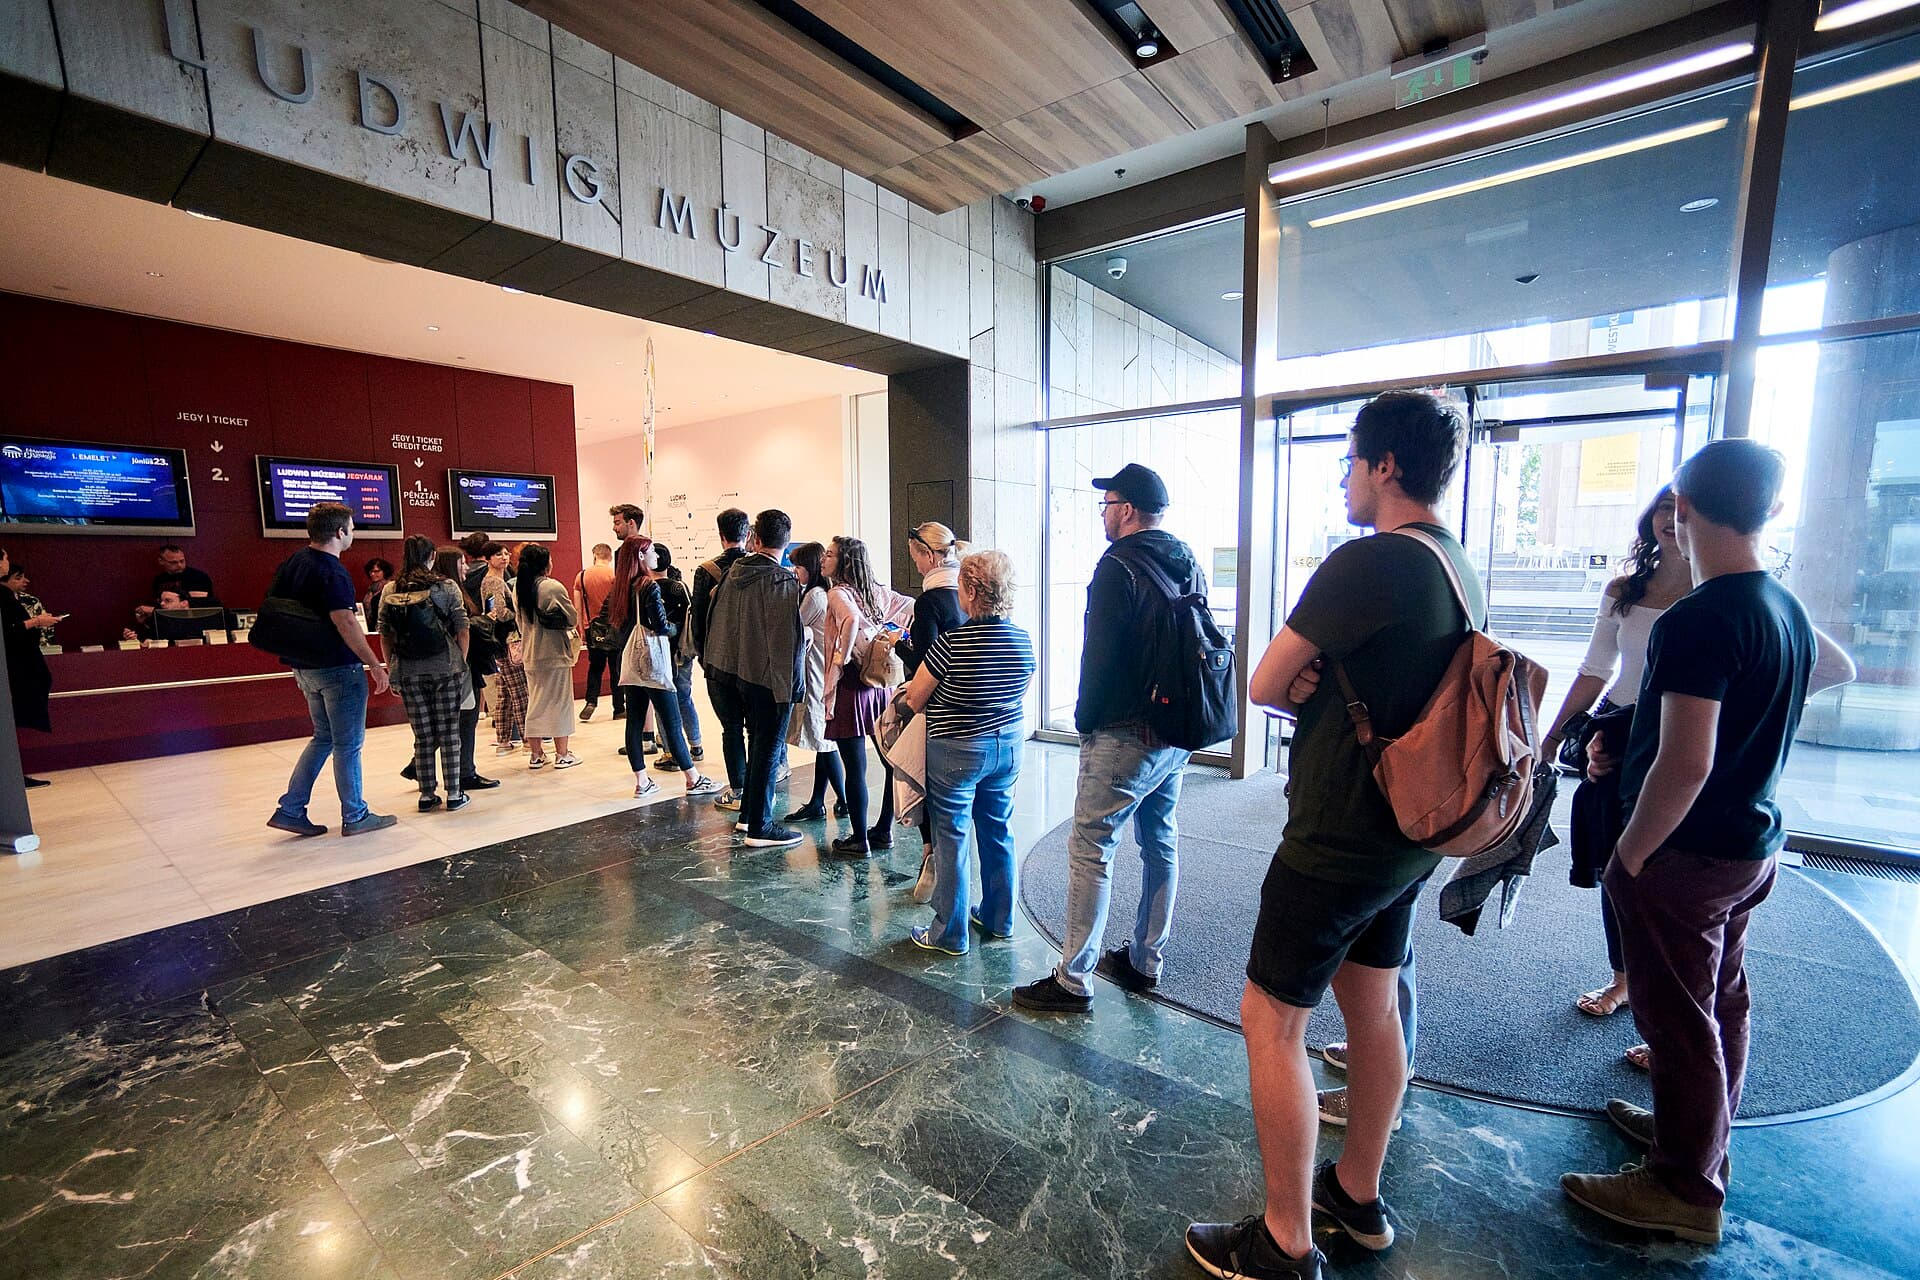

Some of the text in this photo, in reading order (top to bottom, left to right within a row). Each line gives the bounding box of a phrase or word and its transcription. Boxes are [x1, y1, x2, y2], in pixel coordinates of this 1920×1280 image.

[163, 0, 889, 304] LUDWIG MÚZEUM
[176, 411, 204, 422] JEGY
[212, 415, 249, 427] TICKET
[391, 433, 411, 443] JEGY
[416, 436, 443, 446] TICKET
[392, 441, 443, 453] CREDIT CARD
[211, 467, 230, 481] 2.
[414, 479, 428, 493] 1.
[403, 490, 440, 501] PÉNZTÁR
[409, 499, 436, 508] CASSA
